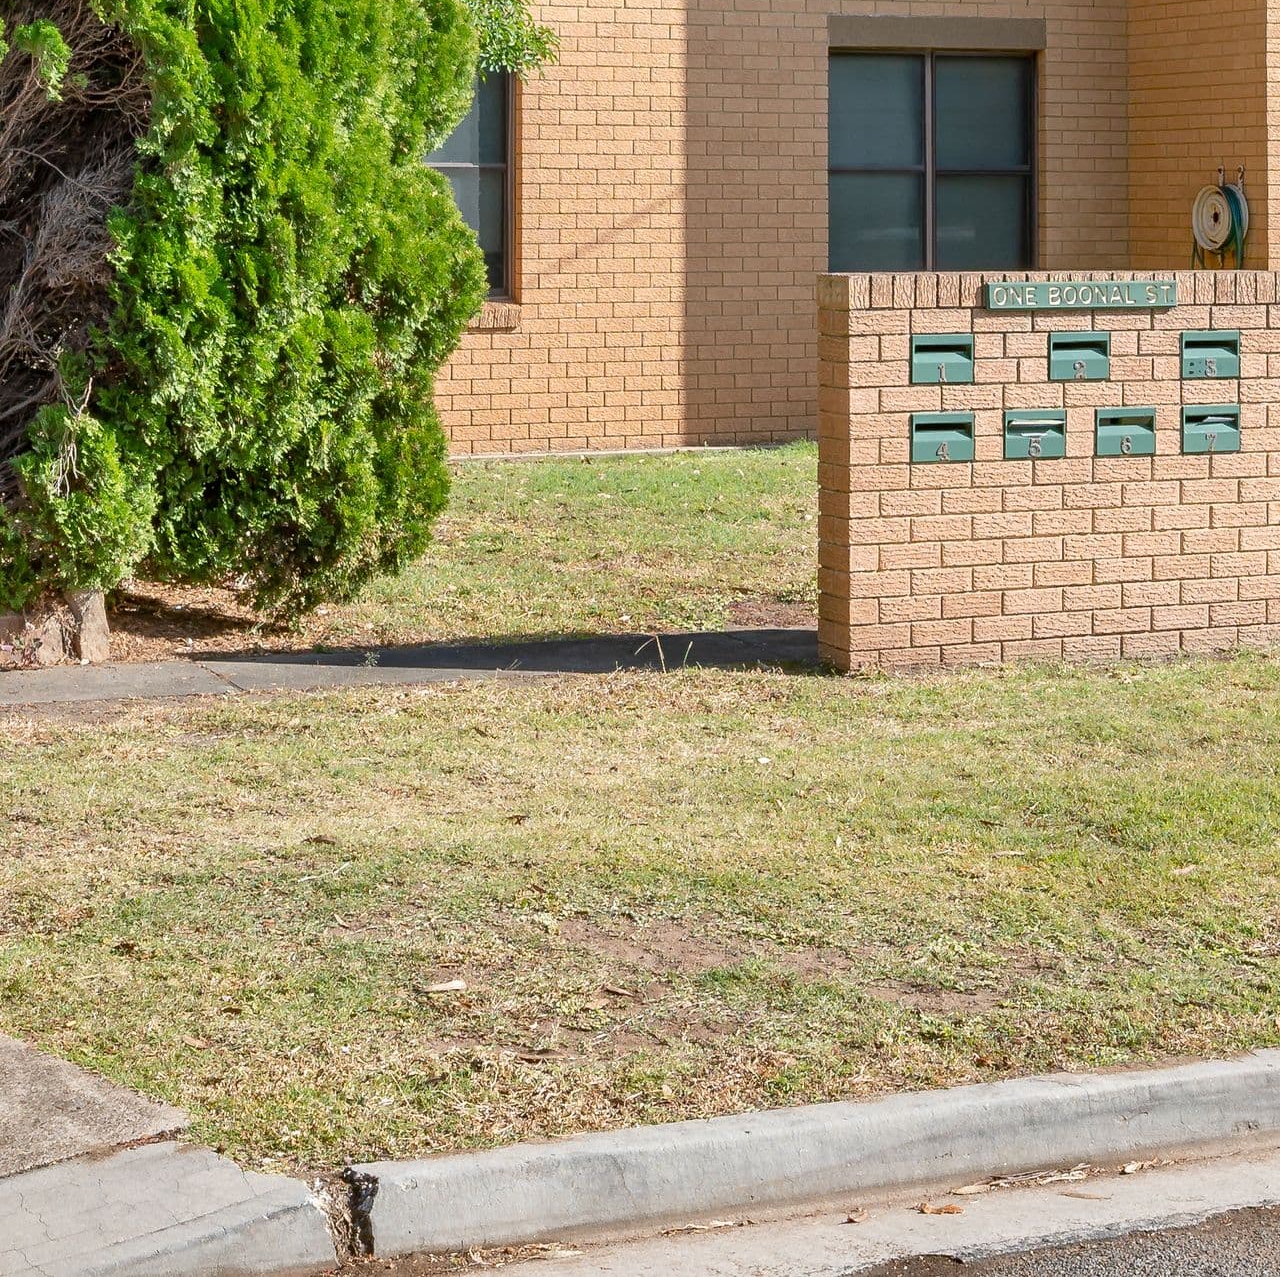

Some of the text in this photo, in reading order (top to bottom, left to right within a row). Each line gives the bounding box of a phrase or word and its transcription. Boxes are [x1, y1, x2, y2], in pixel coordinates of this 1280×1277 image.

[993, 286, 1038, 306] ONE
[1048, 285, 1136, 306] BOONAL
[937, 362, 947, 382] 1
[1072, 360, 1087, 379] 2
[936, 441, 950, 461] 4
[1028, 436, 1042, 457] 5
[1121, 435, 1132, 454] 6
[1204, 433, 1217, 451] 7
